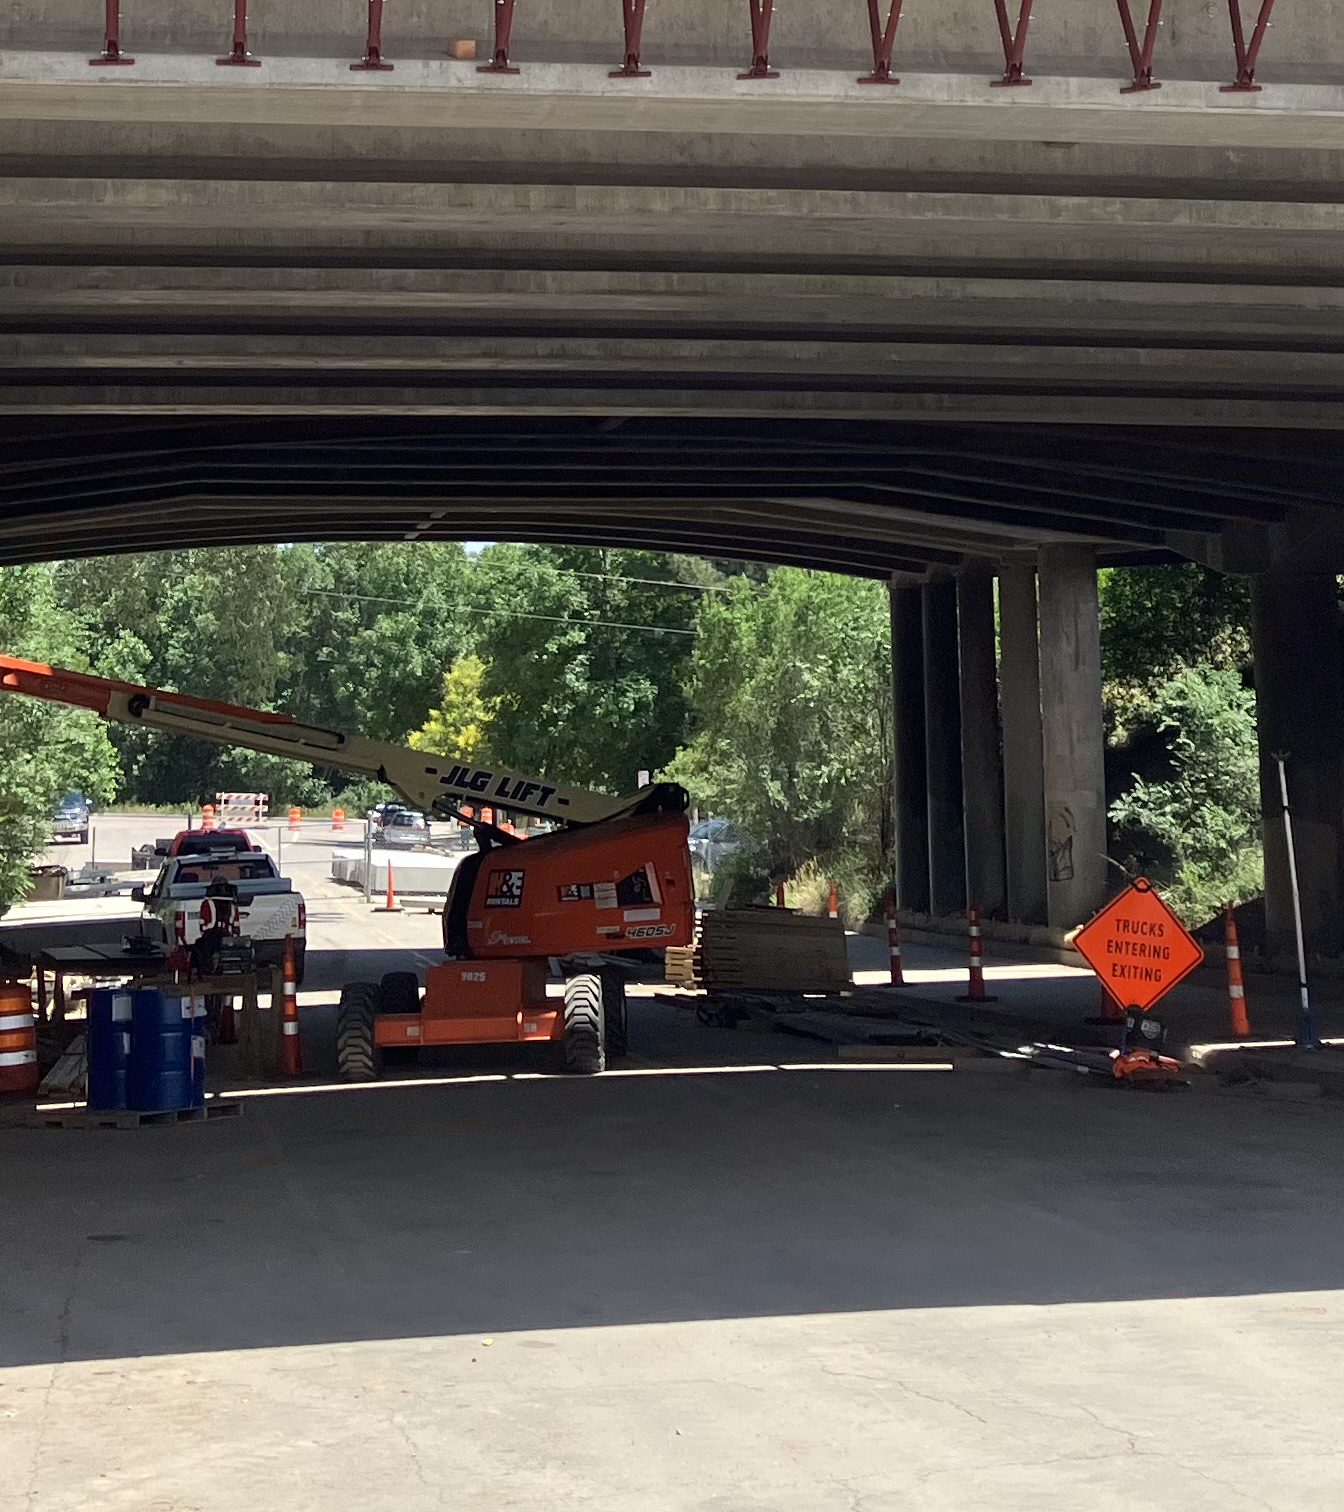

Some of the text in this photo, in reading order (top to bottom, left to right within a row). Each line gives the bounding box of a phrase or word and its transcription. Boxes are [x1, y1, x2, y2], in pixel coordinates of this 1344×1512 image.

[439, 765, 556, 806] JLG LIFT
[488, 871, 524, 896] H&E
[486, 897, 520, 906] RENTALS
[1115, 918, 1165, 938] TRUCKS
[1107, 939, 1170, 960] ENTERING
[1112, 963, 1162, 982] EXITING
